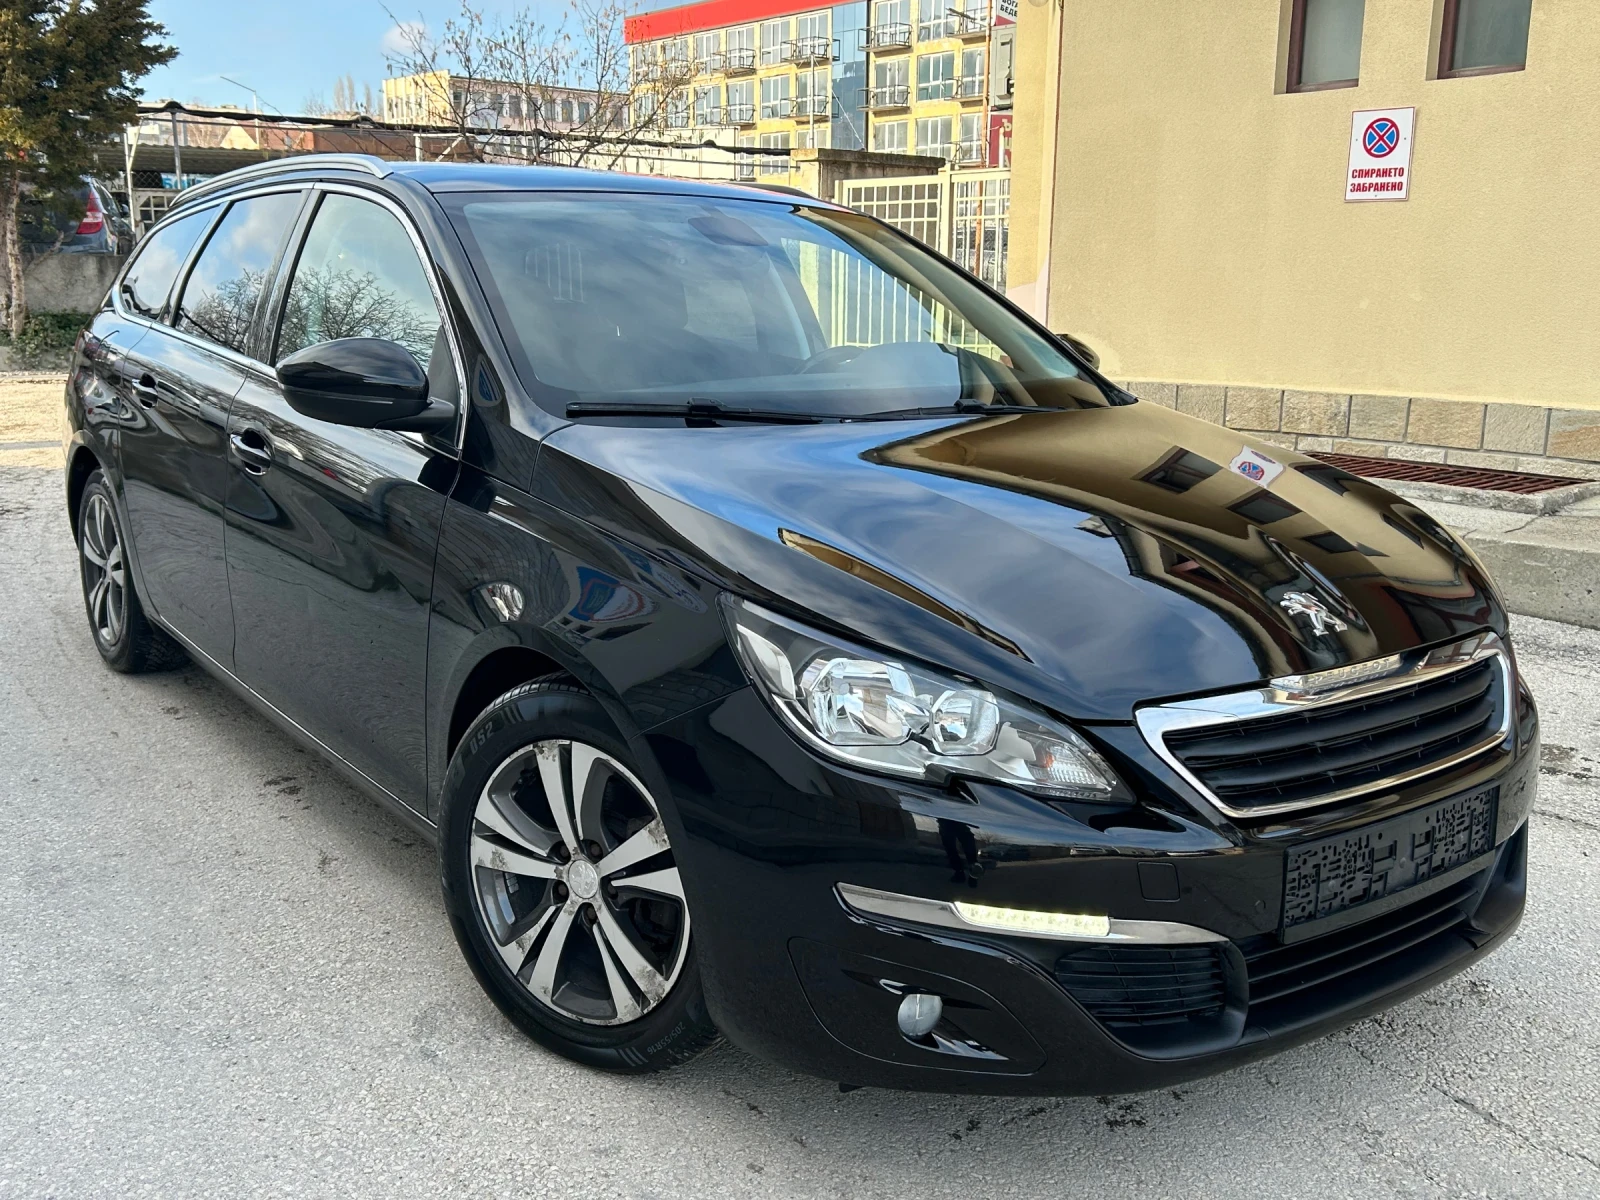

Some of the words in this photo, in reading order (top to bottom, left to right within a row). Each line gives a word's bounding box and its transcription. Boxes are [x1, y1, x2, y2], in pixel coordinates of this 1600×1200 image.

[1351, 167, 1405, 179] СПИРАНЕТО
[1349, 181, 1404, 193] ЗАБРАНЕНО
[1314, 658, 1391, 685] PEUGEOT
[646, 1021, 687, 1055] 205/55R16
